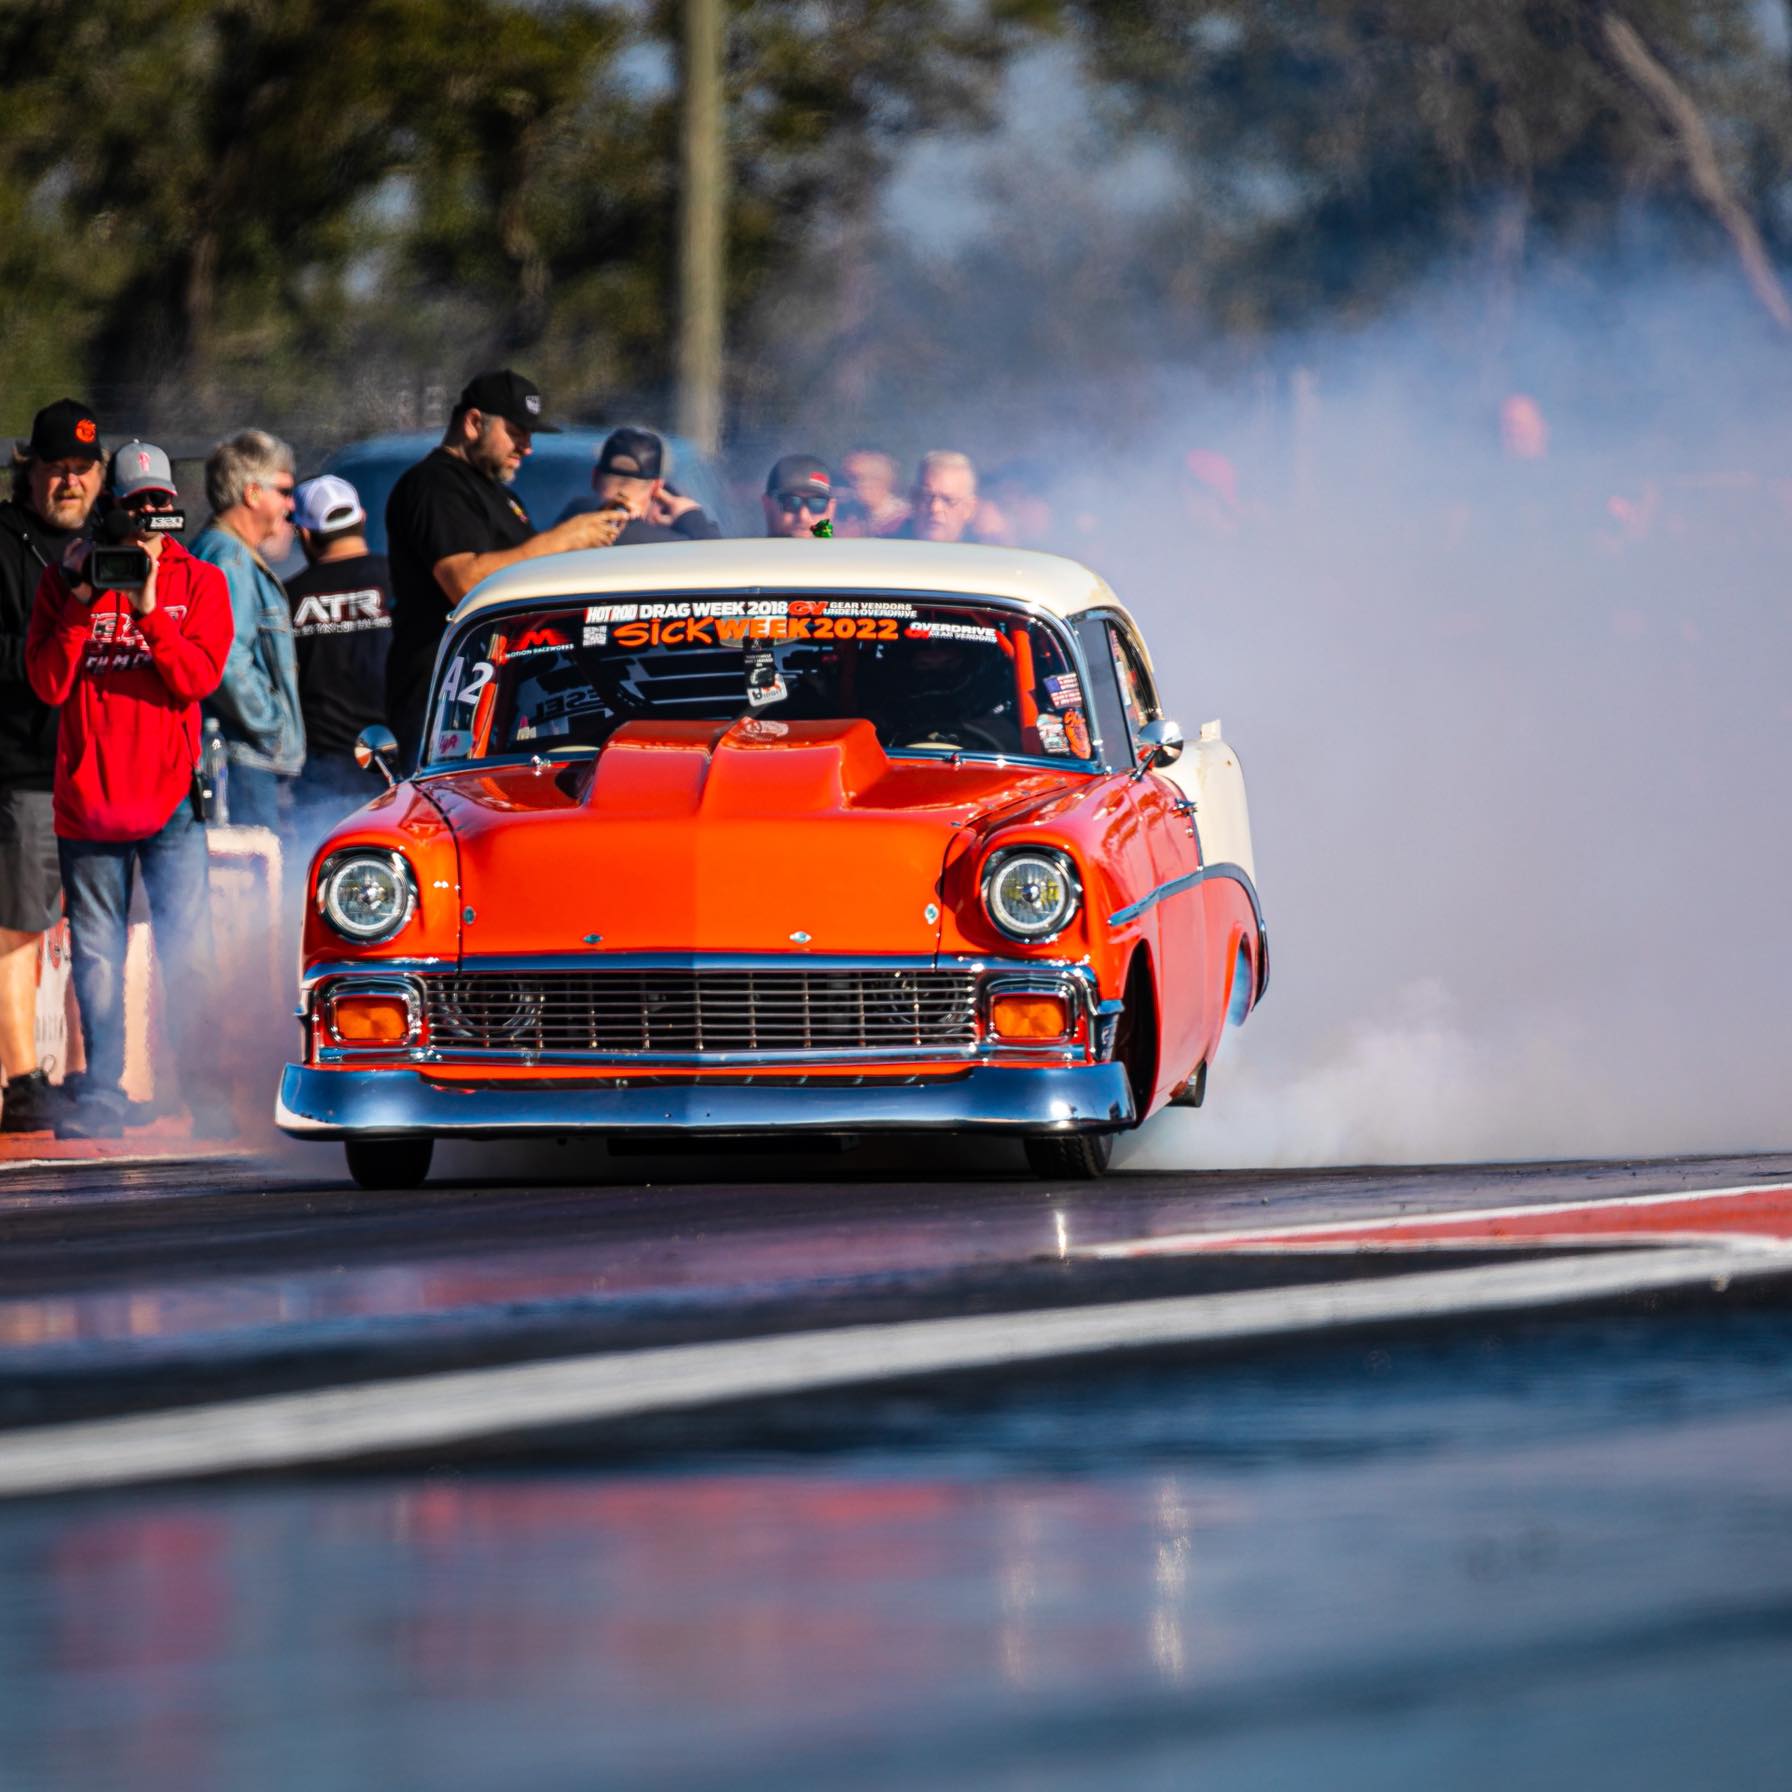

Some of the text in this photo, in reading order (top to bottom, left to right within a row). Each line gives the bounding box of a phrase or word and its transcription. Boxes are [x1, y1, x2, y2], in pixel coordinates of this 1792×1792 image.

[294, 589, 381, 627] ATR
[640, 604, 691, 619] DRAG
[692, 602, 746, 616] WEEK
[747, 601, 788, 615] 2018
[829, 601, 913, 611] GEAR VENDORS
[715, 618, 812, 640] WEEK
[813, 617, 900, 640] 2022
[909, 621, 997, 637] OVERDRIVE
[439, 656, 495, 704] A2
